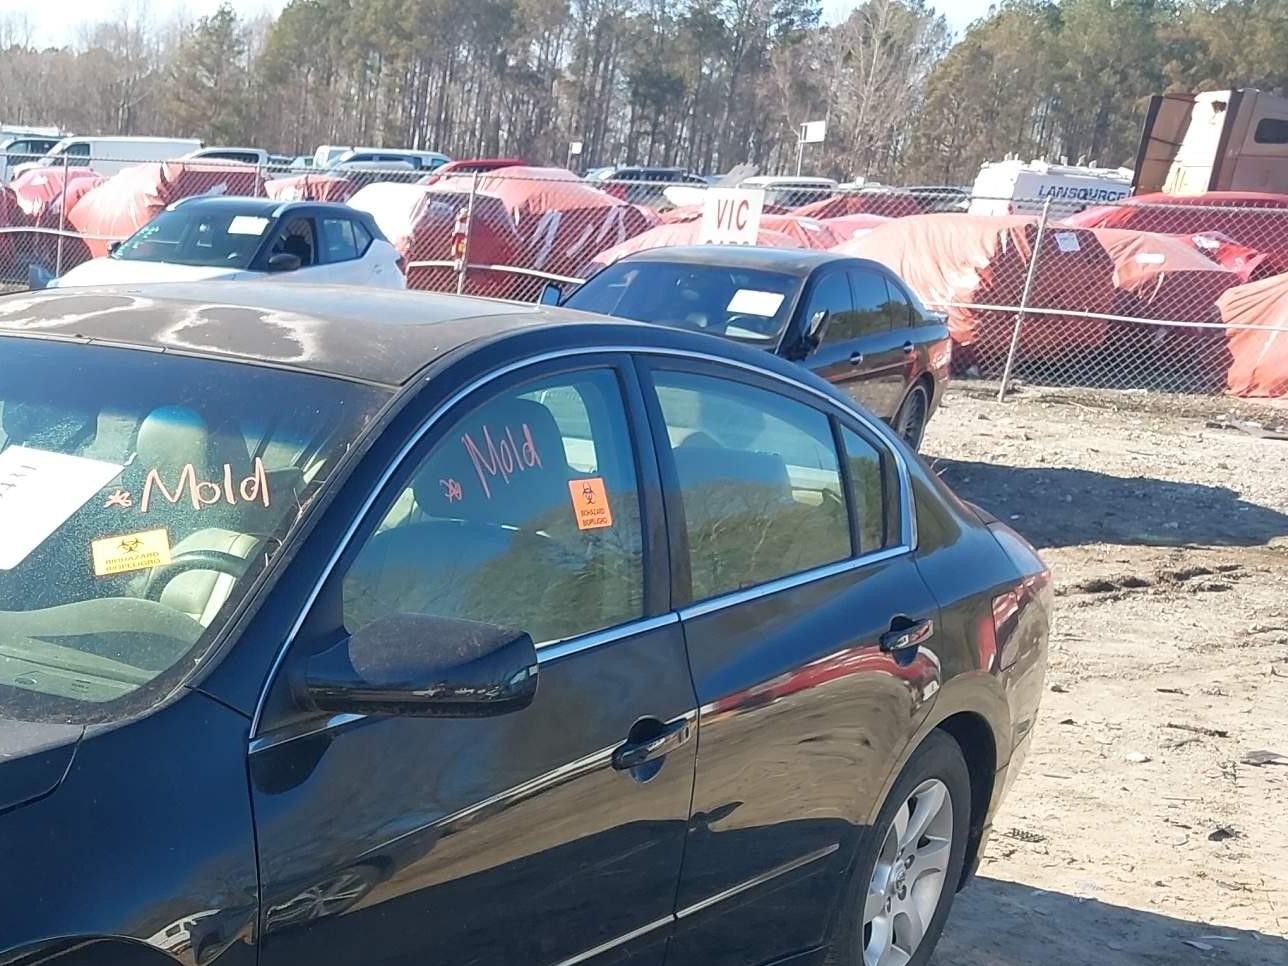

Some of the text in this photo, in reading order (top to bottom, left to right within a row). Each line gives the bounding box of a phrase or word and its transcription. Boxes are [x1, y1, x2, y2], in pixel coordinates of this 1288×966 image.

[716, 199, 749, 230] VIC
[141, 456, 270, 513] Mold
[460, 423, 543, 499] Mold
